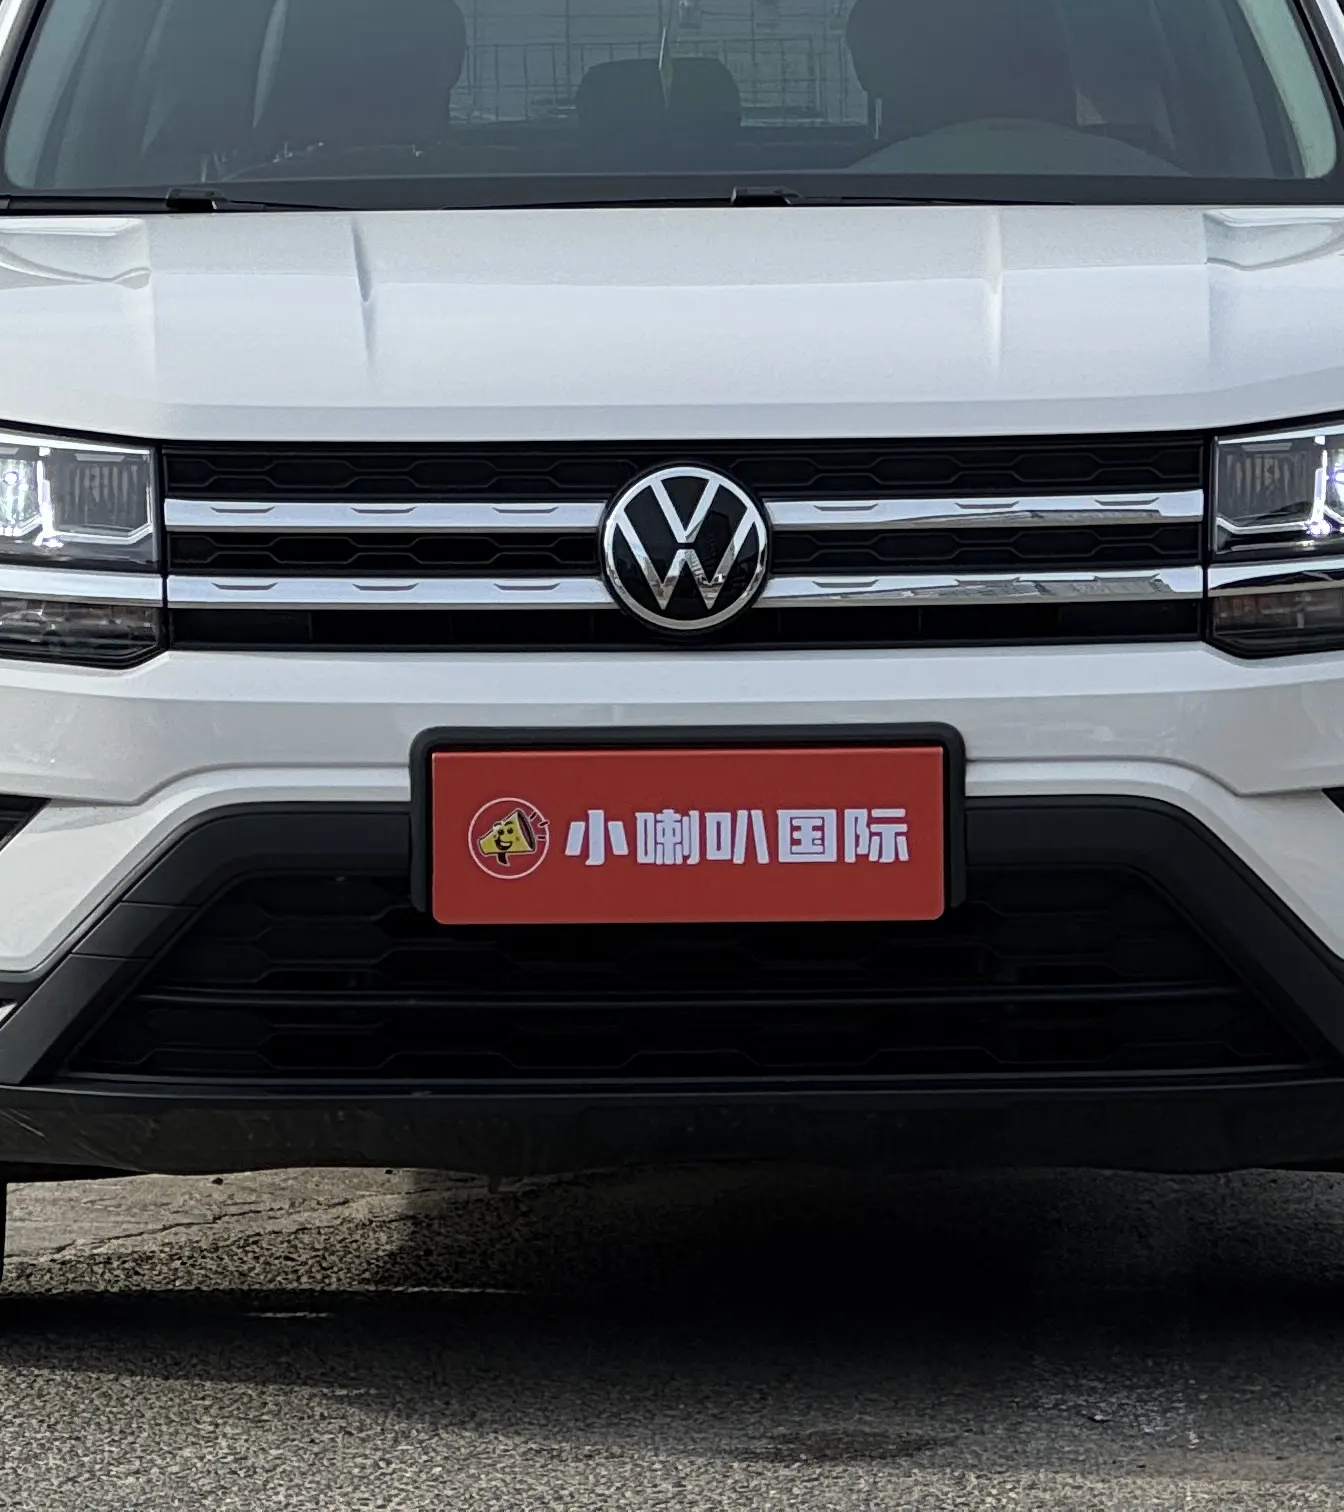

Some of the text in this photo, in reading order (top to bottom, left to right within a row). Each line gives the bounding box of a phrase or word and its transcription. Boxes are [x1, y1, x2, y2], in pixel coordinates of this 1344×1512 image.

[564, 808, 909, 866] 小喇叭国际
